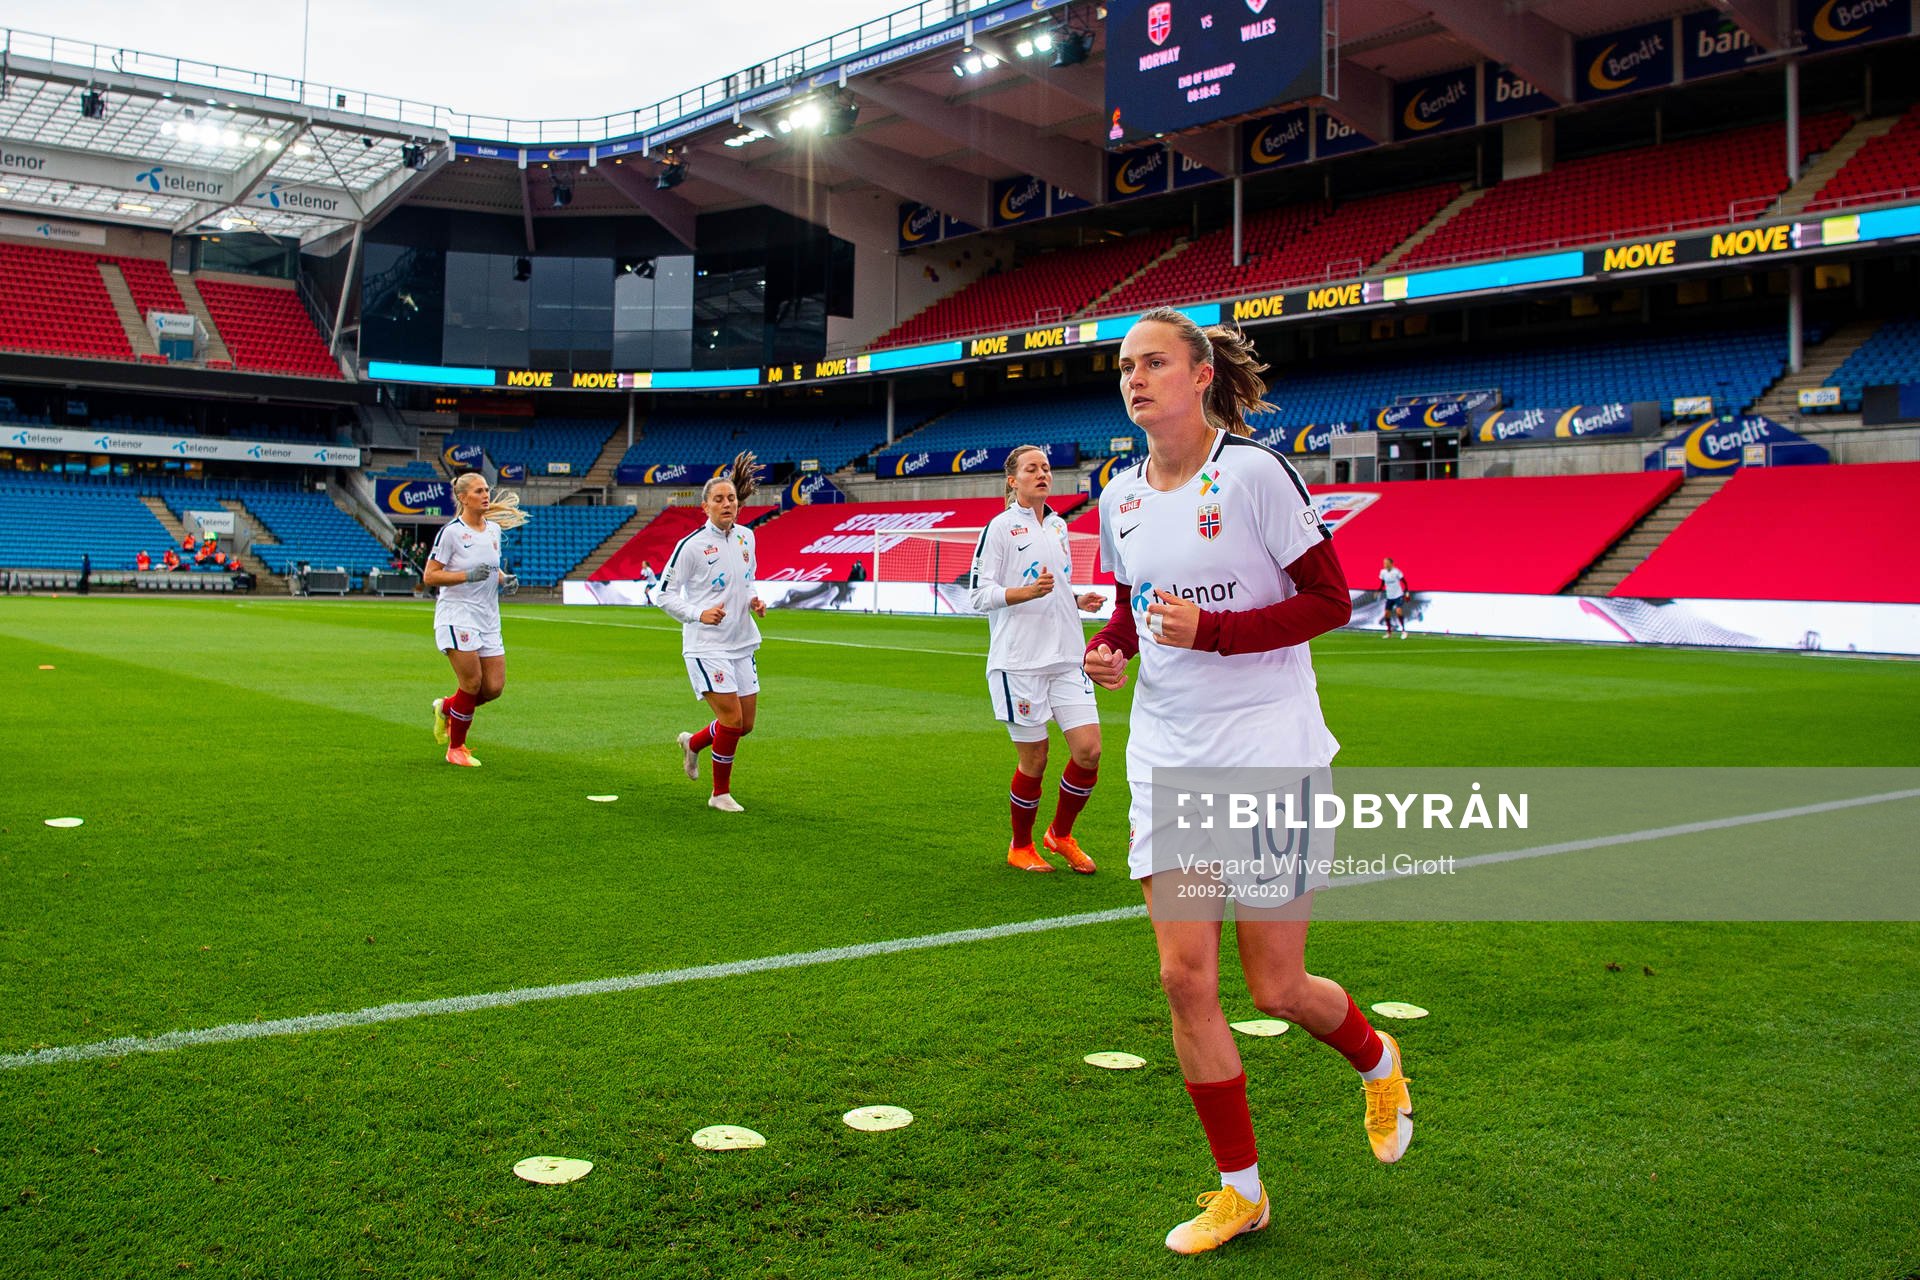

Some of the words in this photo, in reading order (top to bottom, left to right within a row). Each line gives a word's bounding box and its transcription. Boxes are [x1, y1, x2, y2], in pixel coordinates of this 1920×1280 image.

[1201, 15, 1213, 29] VS
[1240, 18, 1277, 42] WALES
[846, 56, 880, 74] OPPLEV
[881, 27, 964, 62] BENDIT-EFFEKTEN
[1139, 46, 1181, 72] NORWAY
[1608, 33, 1664, 77] Bendit
[1193, 71, 1203, 84] OF
[1204, 62, 1236, 82] WARMUP
[1419, 79, 1467, 118] Bendit
[1264, 119, 1305, 153] Bendit
[1127, 151, 1162, 183] Bendit
[164, 174, 224, 196] telenor
[1010, 182, 1041, 210] Bendit
[283, 190, 339, 213] telenor
[50, 226, 81, 239] telenor
[1710, 225, 1790, 258] MOVE
[1603, 240, 1677, 272] MOVE
[1234, 295, 1285, 321] MOVE
[1307, 283, 1362, 311] MOVE
[164, 317, 192, 329] telenor
[971, 336, 1009, 357] MOVE
[1024, 327, 1065, 350] MOVE
[508, 371, 553, 387] MOVE
[816, 359, 848, 378] MOVE
[572, 372, 617, 389] MOVE
[1384, 406, 1411, 425] Bendit
[1433, 402, 1460, 421] Bendit
[1573, 402, 1625, 434] Bendit
[1496, 408, 1546, 440] Bendit
[1705, 415, 1770, 455] Bendit
[27, 433, 64, 446] telenor
[107, 438, 144, 451] telenor
[1308, 421, 1347, 451] Bendit
[184, 442, 219, 455] telenor
[259, 447, 292, 459] telenor
[325, 450, 357, 463] telenor
[454, 445, 482, 461] Bendit
[961, 448, 988, 472] Bendit
[655, 464, 688, 484] Bendit
[904, 450, 931, 475] Bendit
[403, 481, 446, 506] Bendit
[800, 473, 825, 496] Bendit
[1120, 500, 1140, 514] TINE
[202, 516, 231, 528] telenor
[765, 562, 833, 581] DNB
[1152, 580, 1237, 605] tlenor
